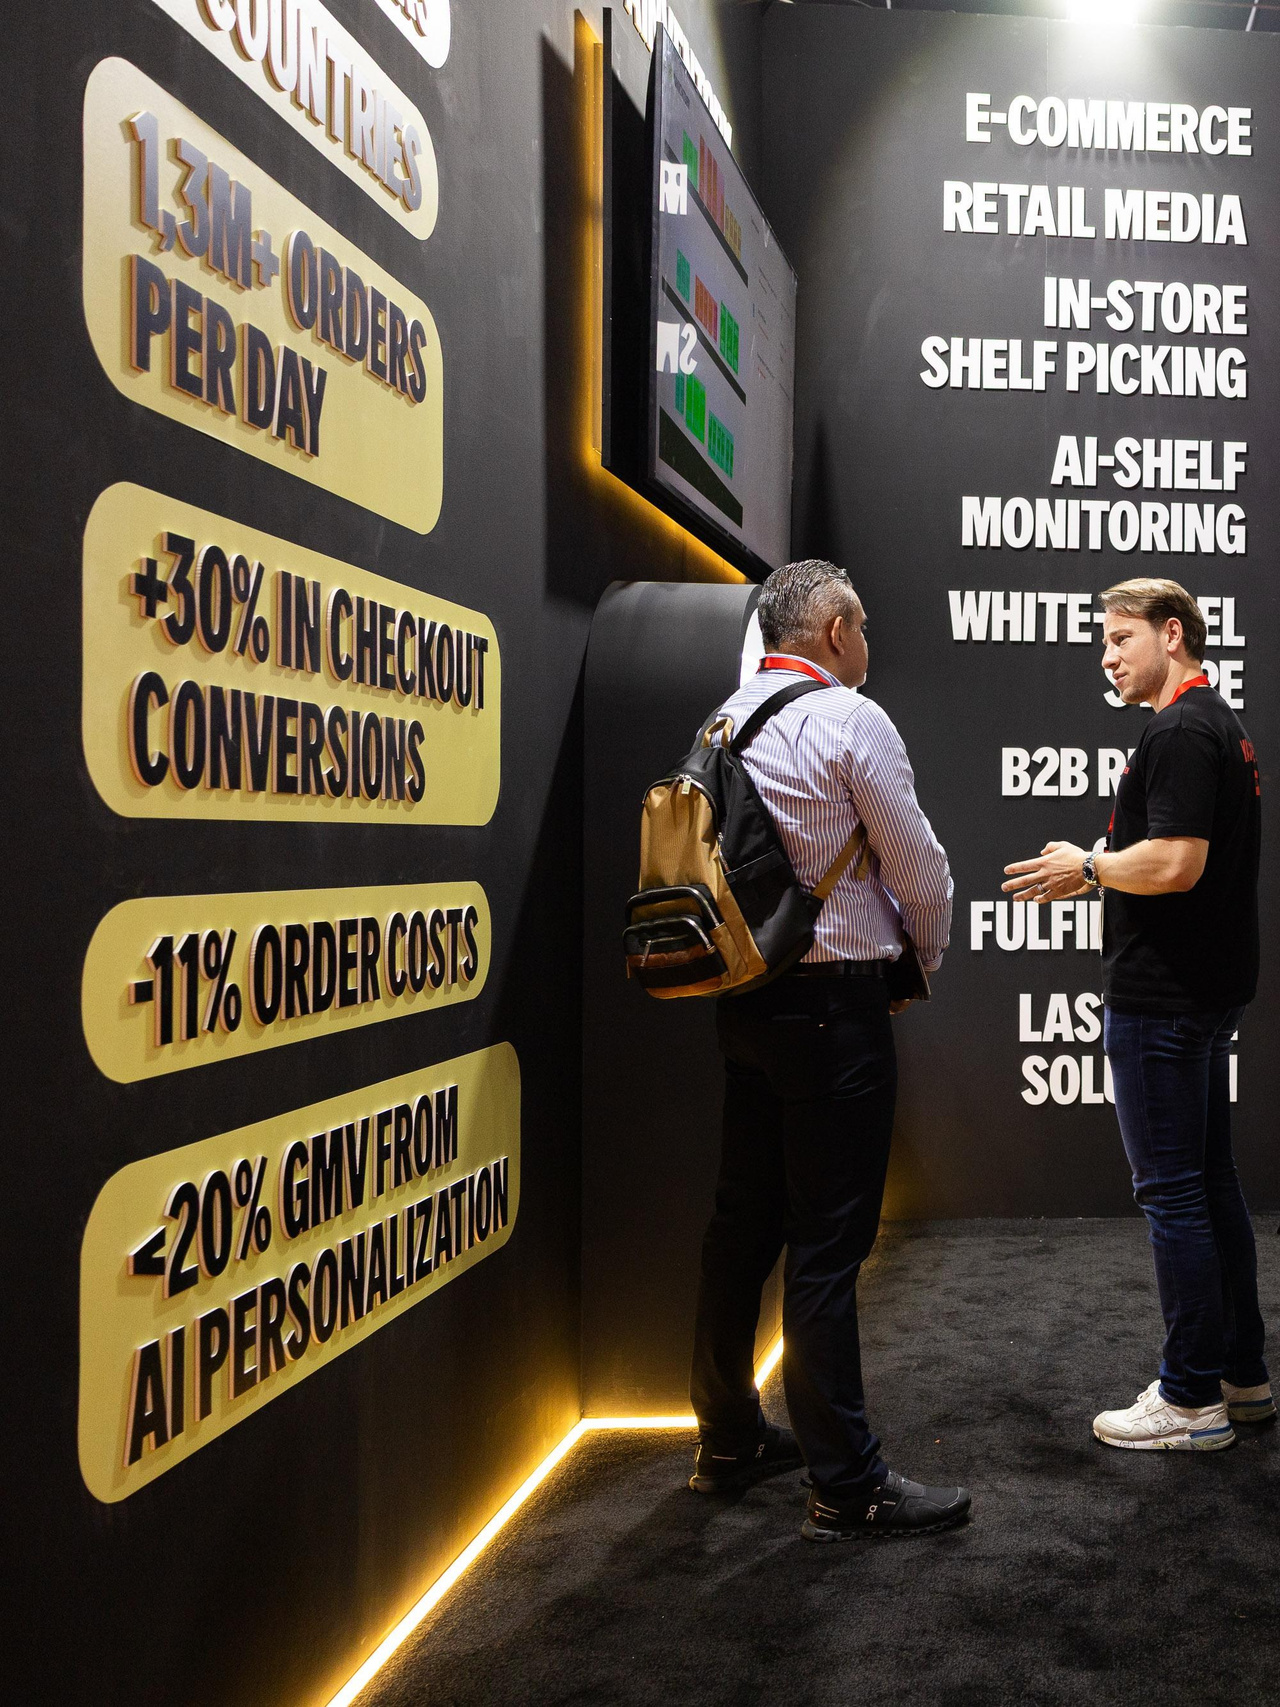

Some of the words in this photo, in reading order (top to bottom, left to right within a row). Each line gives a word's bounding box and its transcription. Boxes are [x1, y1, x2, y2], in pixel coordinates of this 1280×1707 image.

[966, 92, 1253, 156] E-COMMERCE
[943, 180, 1096, 238] RETAIL
[1104, 188, 1248, 245] MEDIA
[285, 230, 428, 405] ORDERS
[1044, 276, 1248, 335] IN-STORE
[129, 254, 239, 415] PER
[241, 322, 328, 458] DAY
[919, 336, 1058, 391] SHELF
[1066, 341, 1247, 398] PICKING
[1050, 435, 1248, 490] AI-SHELF
[961, 496, 1247, 554] MONITORING
[130, 531, 271, 663] +30%
[275, 570, 322, 674] IN
[327, 587, 489, 710] CHECKOUT
[128, 671, 426, 803] CONVERSIONS
[1001, 747, 1089, 797] B2B
[129, 927, 242, 1046] -11%
[249, 916, 381, 1026] ORDER
[384, 905, 479, 998] COSTS
[280, 1117, 371, 1241] GMV
[372, 1084, 459, 1198] FROM
[123, 1326, 185, 1468] AI
[194, 1156, 510, 1422] PERSONALIZATION
